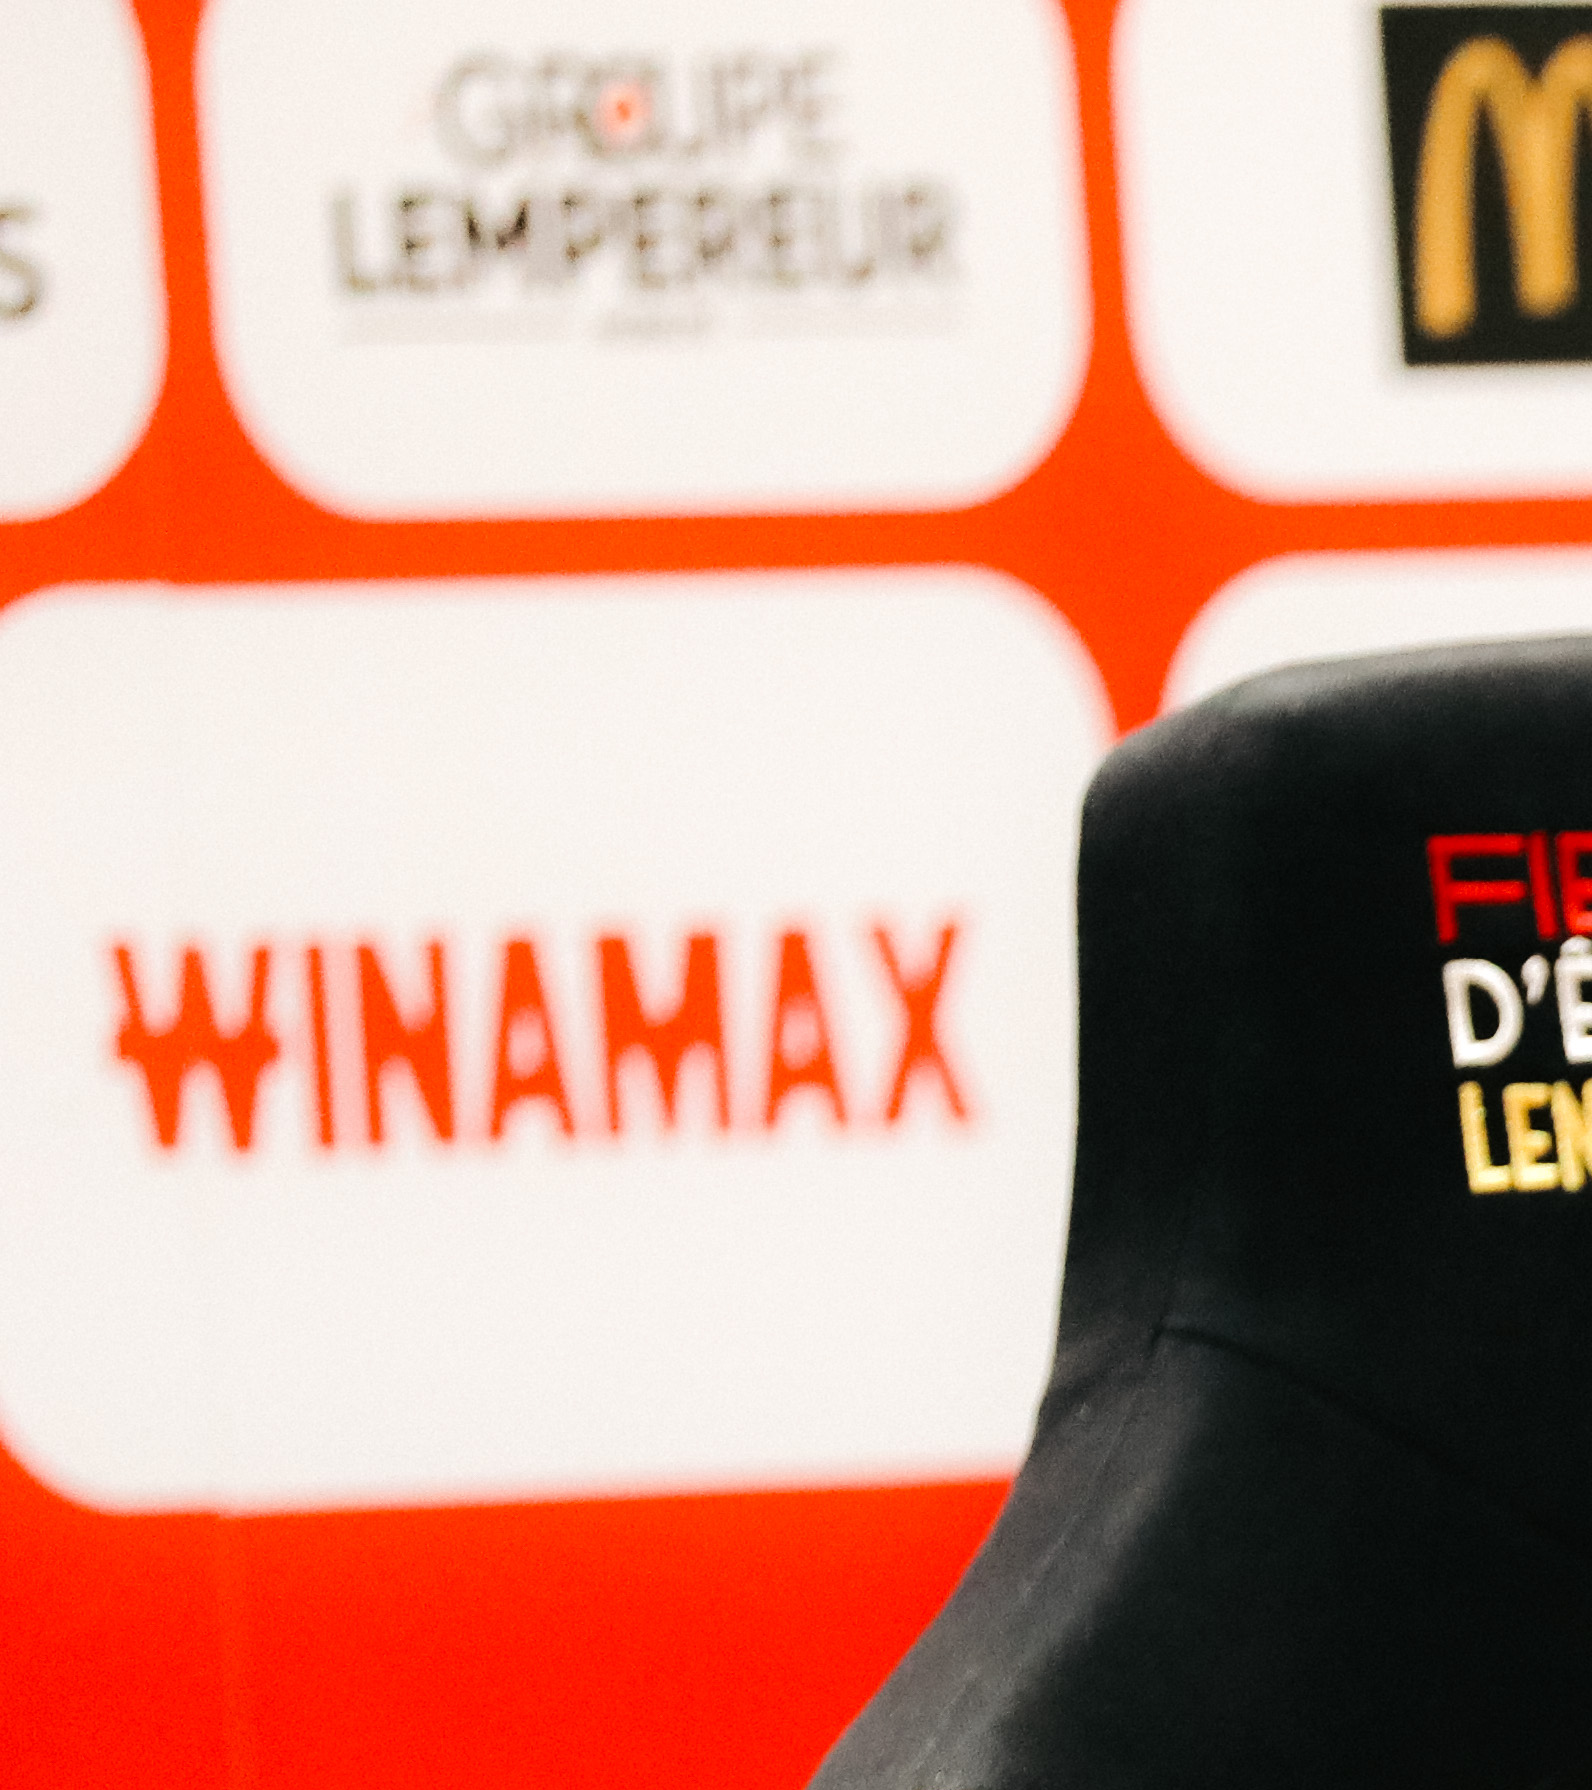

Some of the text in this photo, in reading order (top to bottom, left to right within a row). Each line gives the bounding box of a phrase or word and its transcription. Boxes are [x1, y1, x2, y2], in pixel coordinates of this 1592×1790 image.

[432, 50, 846, 168] GROUPE
[328, 180, 962, 297] LEMPEREUR
[110, 918, 975, 1155] WINAMAX
